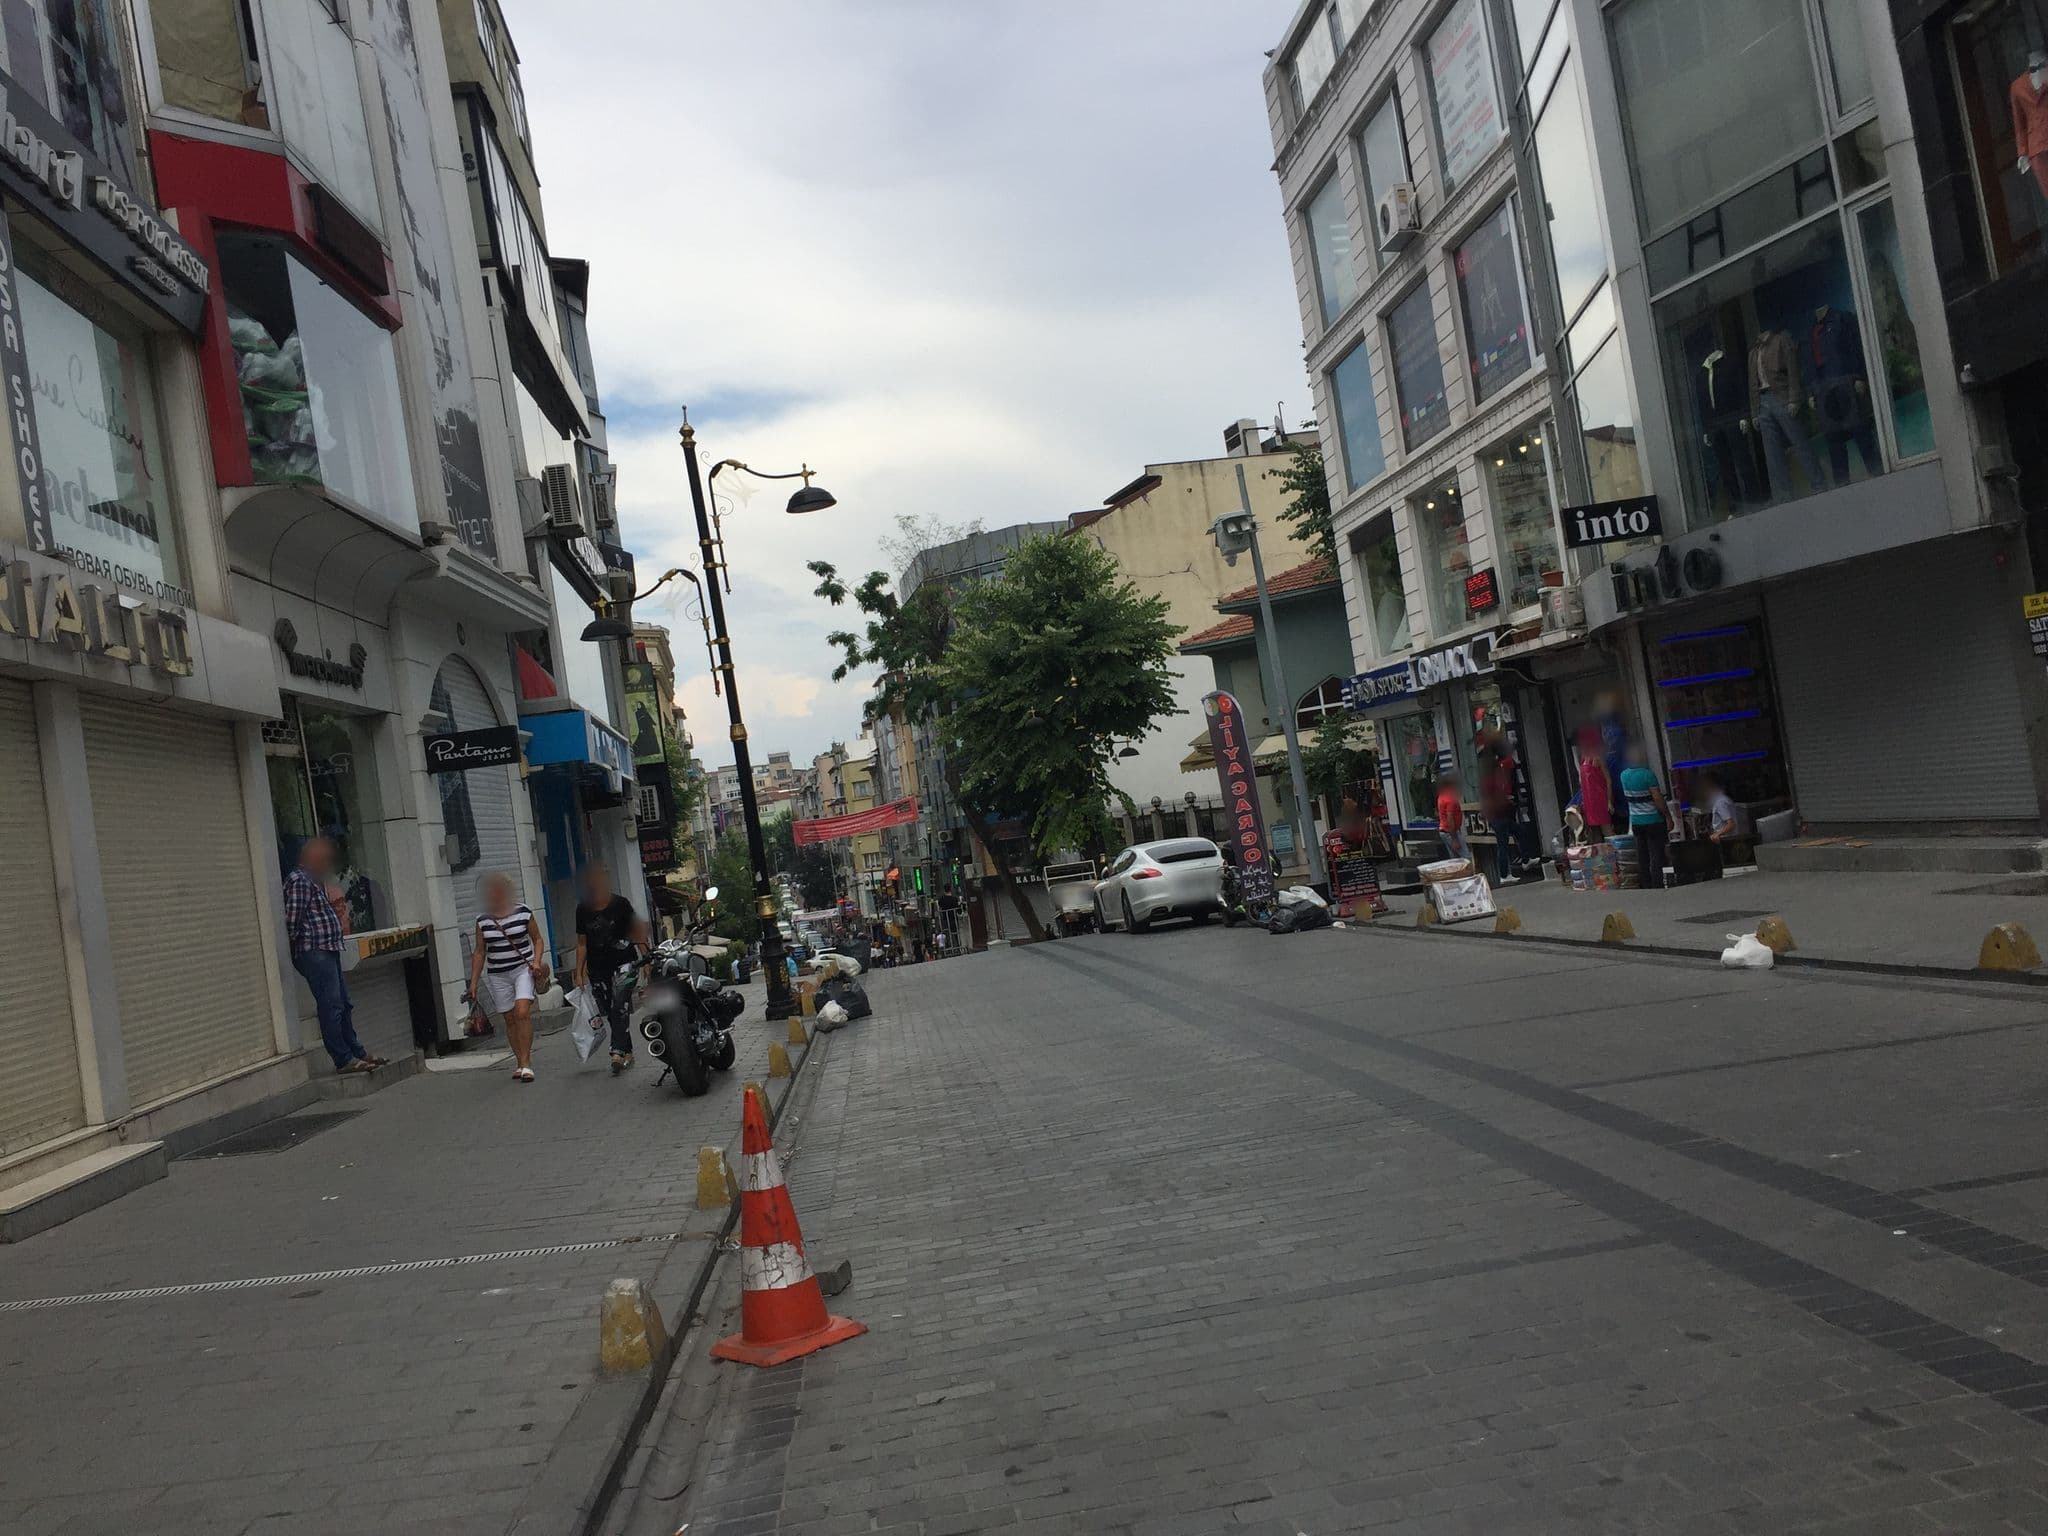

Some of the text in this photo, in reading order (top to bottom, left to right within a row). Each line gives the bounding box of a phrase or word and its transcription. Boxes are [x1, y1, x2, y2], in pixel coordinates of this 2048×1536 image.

[12, 375, 46, 550] SHOES
[1576, 505, 1649, 543] into
[114, 565, 154, 596] ОБУВЬ
[156, 581, 197, 610] ОПТОМ
[482, 752, 512, 762] JEANS
